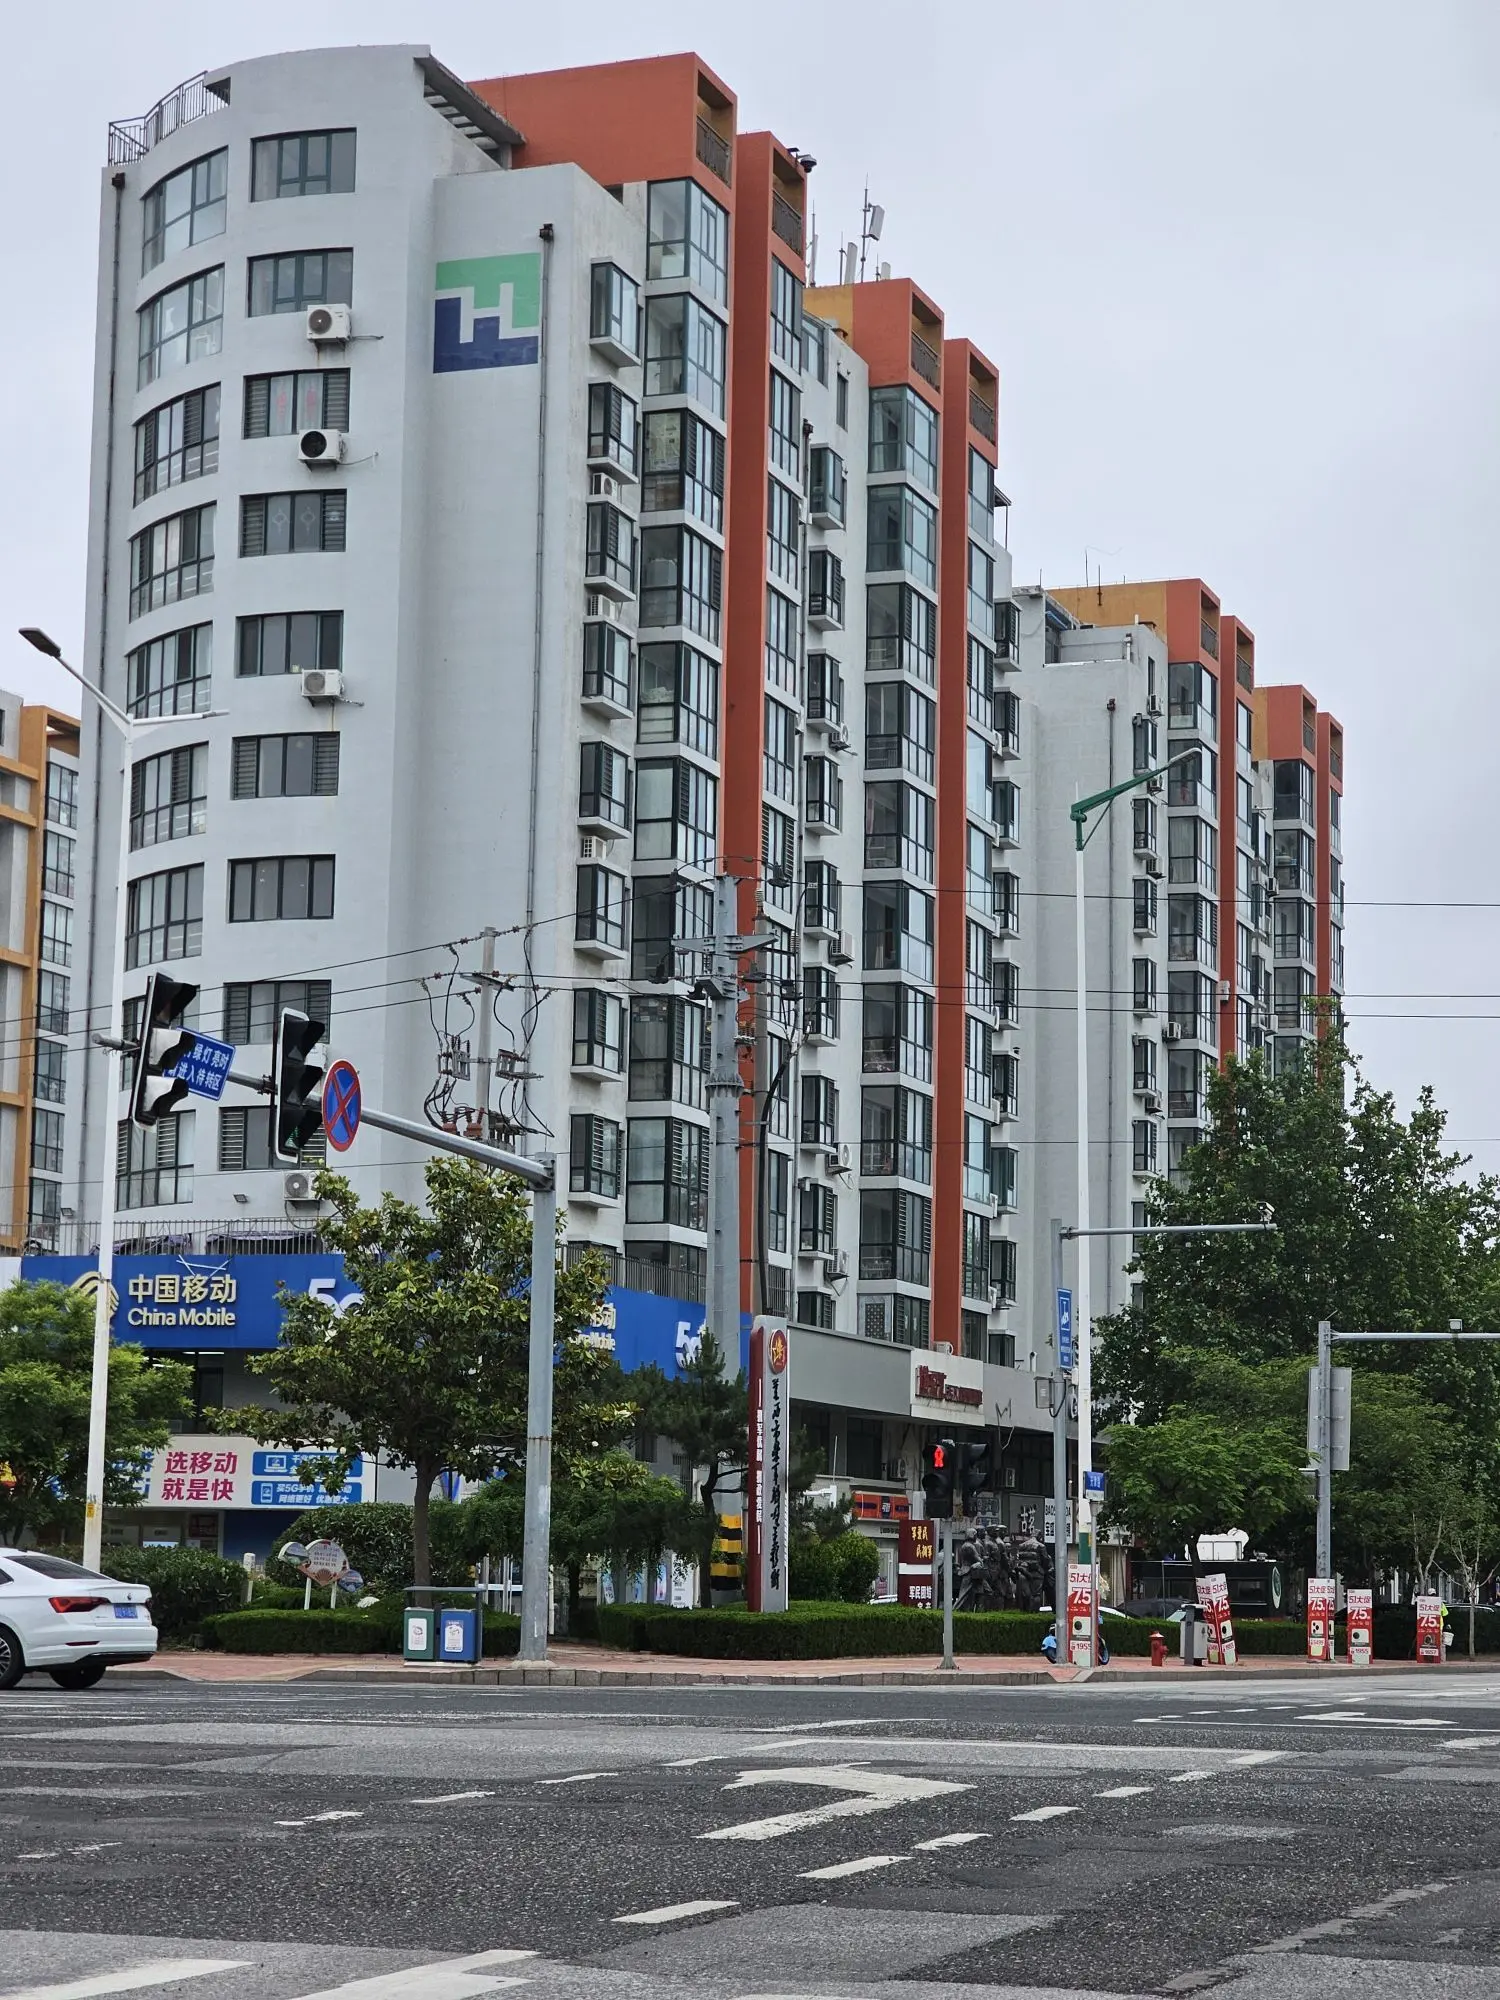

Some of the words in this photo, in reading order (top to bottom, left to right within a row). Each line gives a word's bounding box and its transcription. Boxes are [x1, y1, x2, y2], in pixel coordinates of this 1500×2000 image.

[183, 1043, 230, 1070] 绿灯亮时
[128, 1274, 237, 1304] 中国移动
[127, 1308, 176, 1326] China
[178, 1309, 236, 1326] Mobile
[164, 1451, 238, 1475] 选移动
[161, 1478, 235, 1501] 就是快
